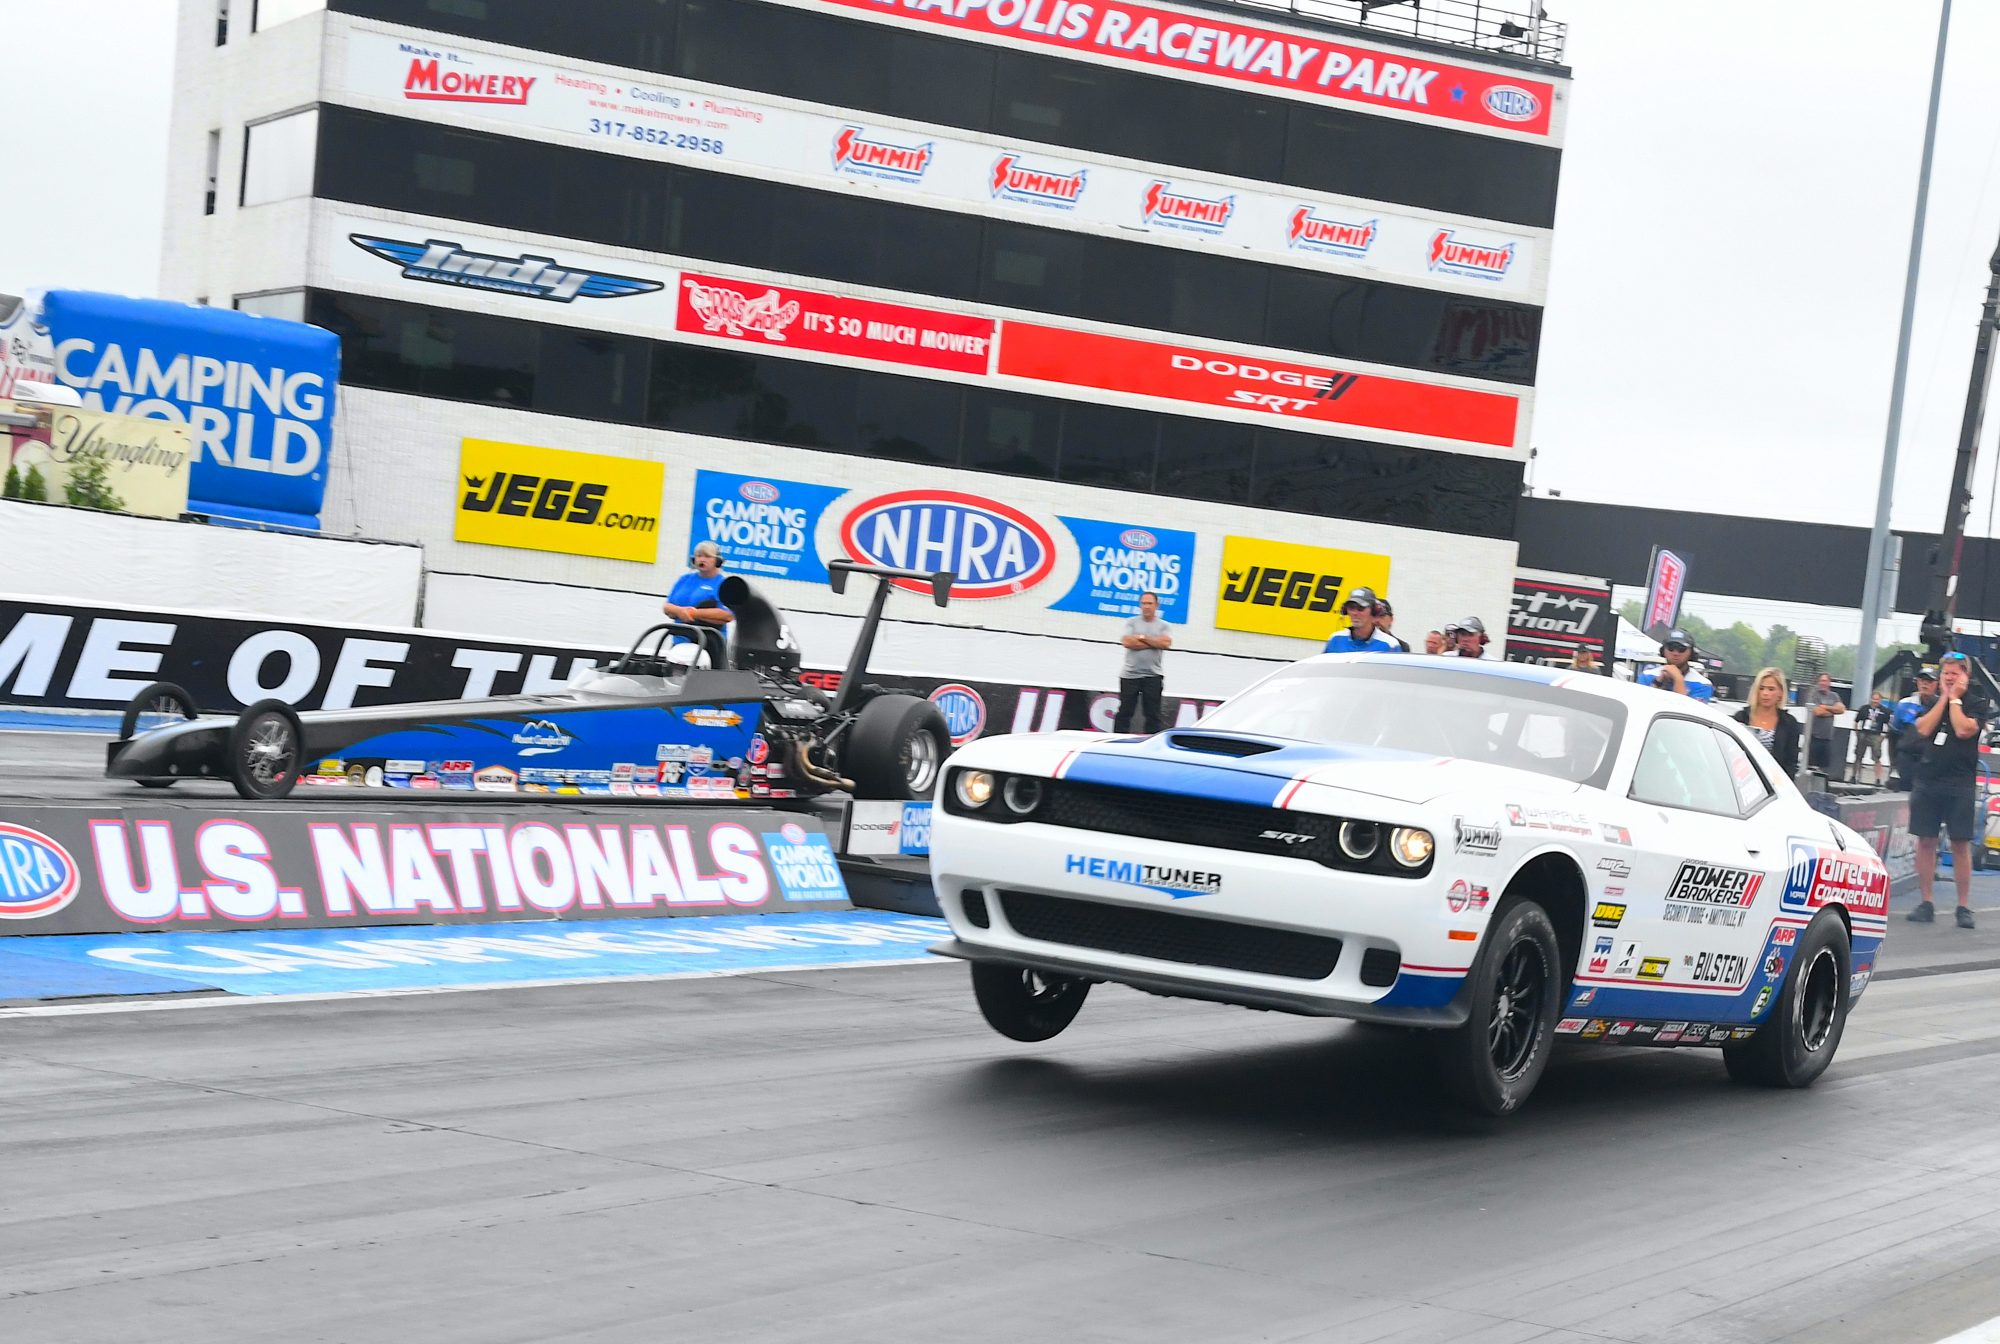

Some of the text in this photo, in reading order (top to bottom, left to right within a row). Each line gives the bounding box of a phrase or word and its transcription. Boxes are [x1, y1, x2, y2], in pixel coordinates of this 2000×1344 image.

[399, 42, 443, 59] Make
[1094, 9, 1320, 80] RACEWAY
[1317, 51, 1439, 105] PARK
[554, 73, 764, 123] Heating Cooling Plumbing
[589, 118, 724, 155] 317-852-2958
[803, 311, 835, 334] IT'S
[839, 316, 863, 337] SO
[865, 320, 917, 346] MUCH
[53, 337, 324, 421] CAMPING
[1171, 354, 1334, 392] DODGE
[1226, 389, 1319, 412] SRT
[706, 498, 807, 529] CAMPING
[706, 517, 805, 551] WORLD
[872, 507, 1027, 582] NHRA
[1089, 545, 1181, 574] CAMPING
[1089, 563, 1179, 595] WORLD
[226, 629, 411, 711] OF
[851, 822, 893, 832] DODGE
[1258, 829, 1316, 844] SRT
[88, 818, 771, 924] U.S. NATIONALS
[768, 845, 833, 866] CAMPING
[777, 864, 840, 889] WORLD
[1669, 864, 1749, 898] POWER
[1677, 884, 1743, 905] BROKERS
[1593, 904, 1626, 920] DRE
[1774, 928, 1796, 943] ARP
[86, 932, 720, 974] CAMPING
[1692, 951, 1749, 985] BILSTEIN
